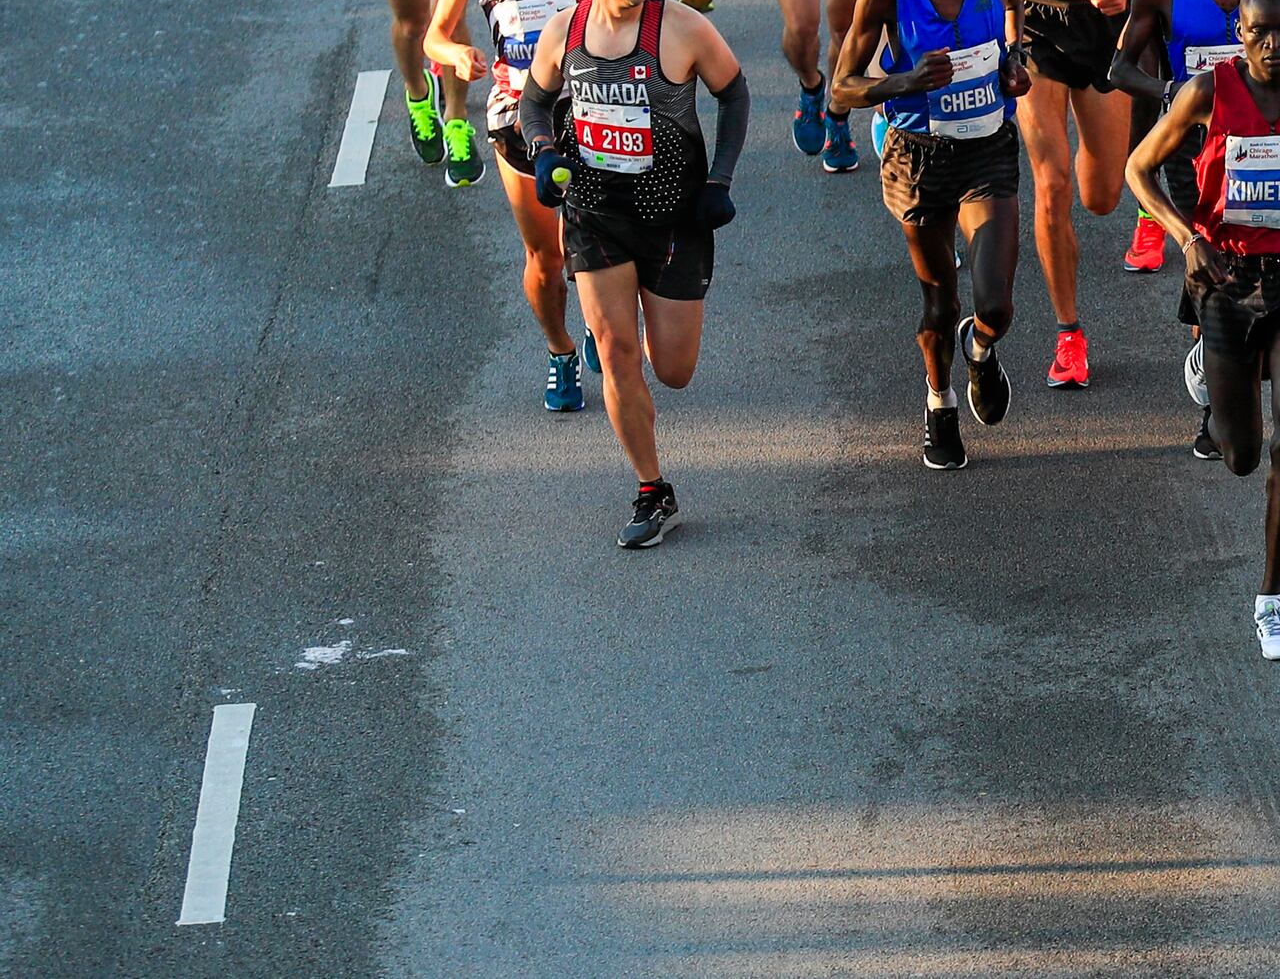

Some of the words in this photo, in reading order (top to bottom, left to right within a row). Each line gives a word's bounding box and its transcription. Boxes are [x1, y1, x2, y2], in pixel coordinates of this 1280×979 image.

[571, 80, 650, 105] CANADA
[583, 125, 595, 147] A
[602, 128, 644, 153] 2193
